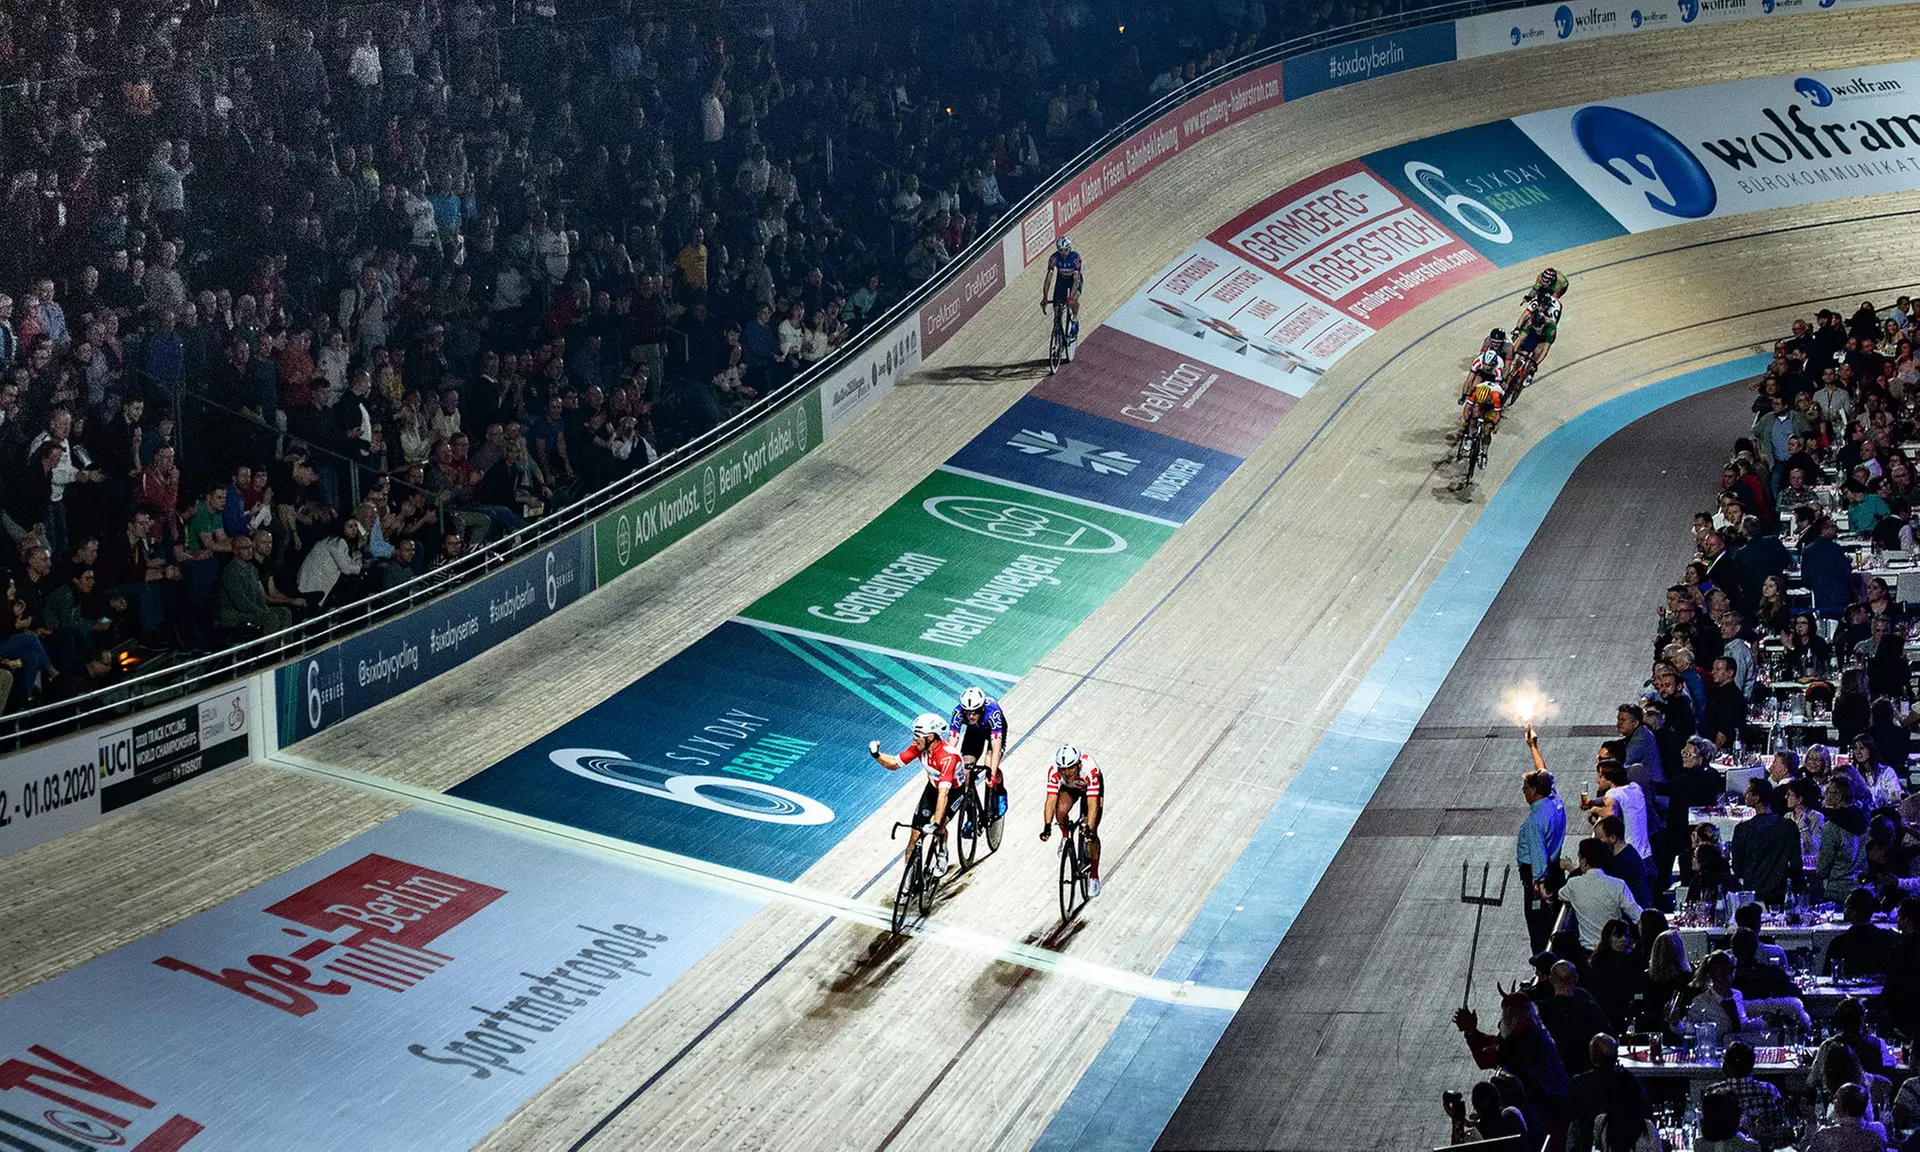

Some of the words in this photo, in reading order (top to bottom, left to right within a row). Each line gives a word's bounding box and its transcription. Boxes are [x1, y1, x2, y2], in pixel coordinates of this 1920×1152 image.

[1522, 28, 1544, 38] wolfram
[1575, 8, 1617, 26] wolfram
[1643, 11, 1668, 21] wolfram
[1329, 41, 1404, 79] #sixdayberlin
[1831, 78, 1902, 96] wolfram
[1701, 104, 1920, 171] wolfram
[1404, 161, 1513, 244] 6
[1465, 172, 1508, 193] SIX
[1504, 163, 1547, 185] DAY
[1485, 184, 1551, 213] BERLIN
[1241, 188, 1369, 263] GRAMBERG-
[1294, 211, 1453, 297] HABERSTROH
[1348, 248, 1478, 319] gramberg-haberstroh.com
[635, 506, 658, 547] AOK
[660, 485, 700, 532] Nordost.
[719, 459, 741, 495] Beim
[742, 441, 767, 484] Sport
[768, 421, 795, 457] dabei.
[545, 551, 557, 610] 6
[556, 569, 574, 589] SERIES
[807, 552, 947, 624] Gemeinsam
[943, 554, 1066, 613] bewegen.
[358, 641, 418, 687] @sixdaycycling
[430, 614, 479, 655] #sixdayseries
[489, 581, 535, 624] #sixdayberlin
[919, 602, 996, 647] mehr
[307, 660, 321, 729] 6
[321, 682, 344, 705] SERIES
[104, 739, 131, 777] UCI
[665, 735, 735, 766] SIX
[703, 708, 769, 739] DAY
[721, 733, 818, 781] BERLIN
[23, 762, 96, 818] 01.03.2020
[180, 757, 202, 777] TISSOT
[548, 748, 836, 825] 6
[325, 874, 468, 934] Berlin
[407, 922, 668, 1079] Sportmetropole
